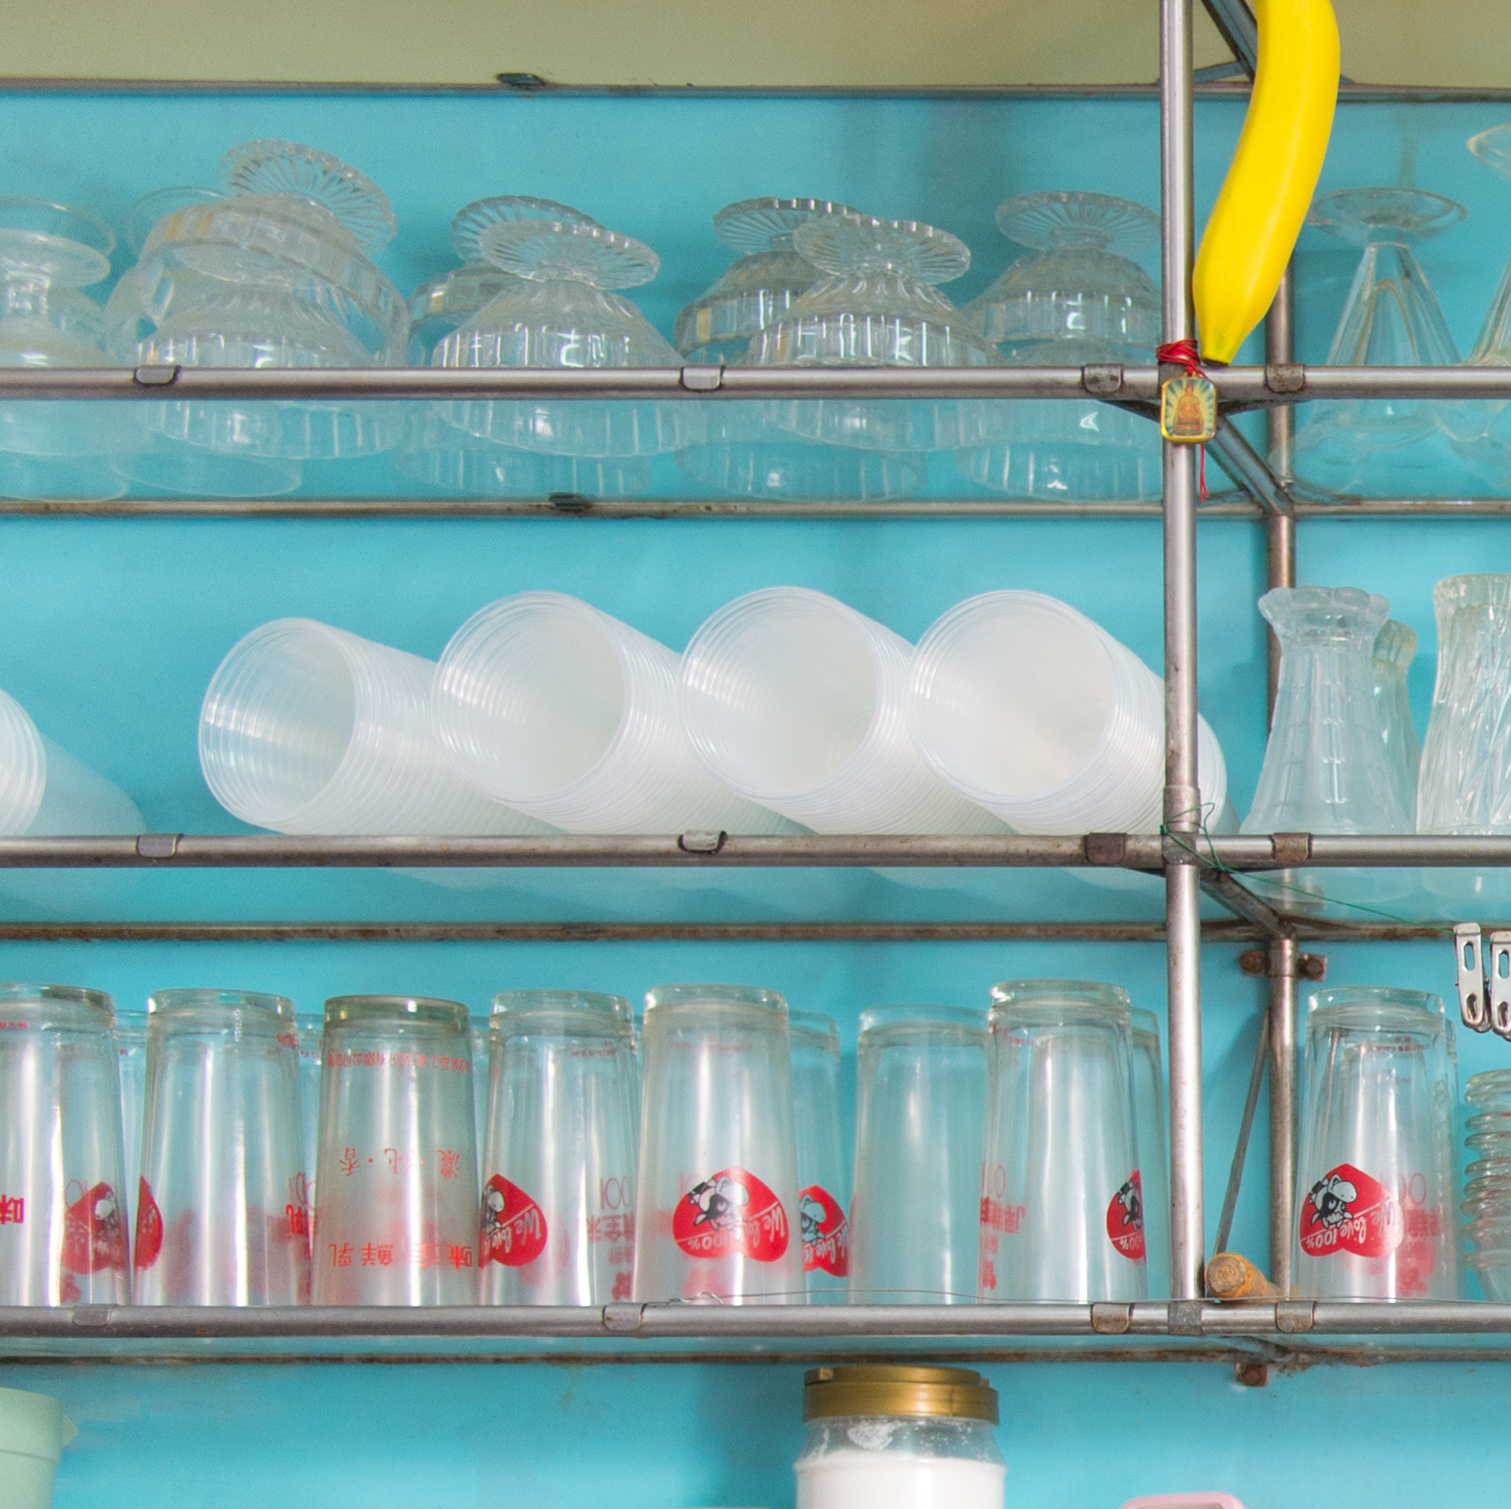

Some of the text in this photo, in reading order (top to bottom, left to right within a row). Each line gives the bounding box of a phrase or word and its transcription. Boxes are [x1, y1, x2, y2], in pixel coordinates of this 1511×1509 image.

[515, 1209, 540, 1246] We
[764, 1205, 785, 1242] We
[1306, 1229, 1337, 1250] 100%
[1340, 1218, 1367, 1245] love
